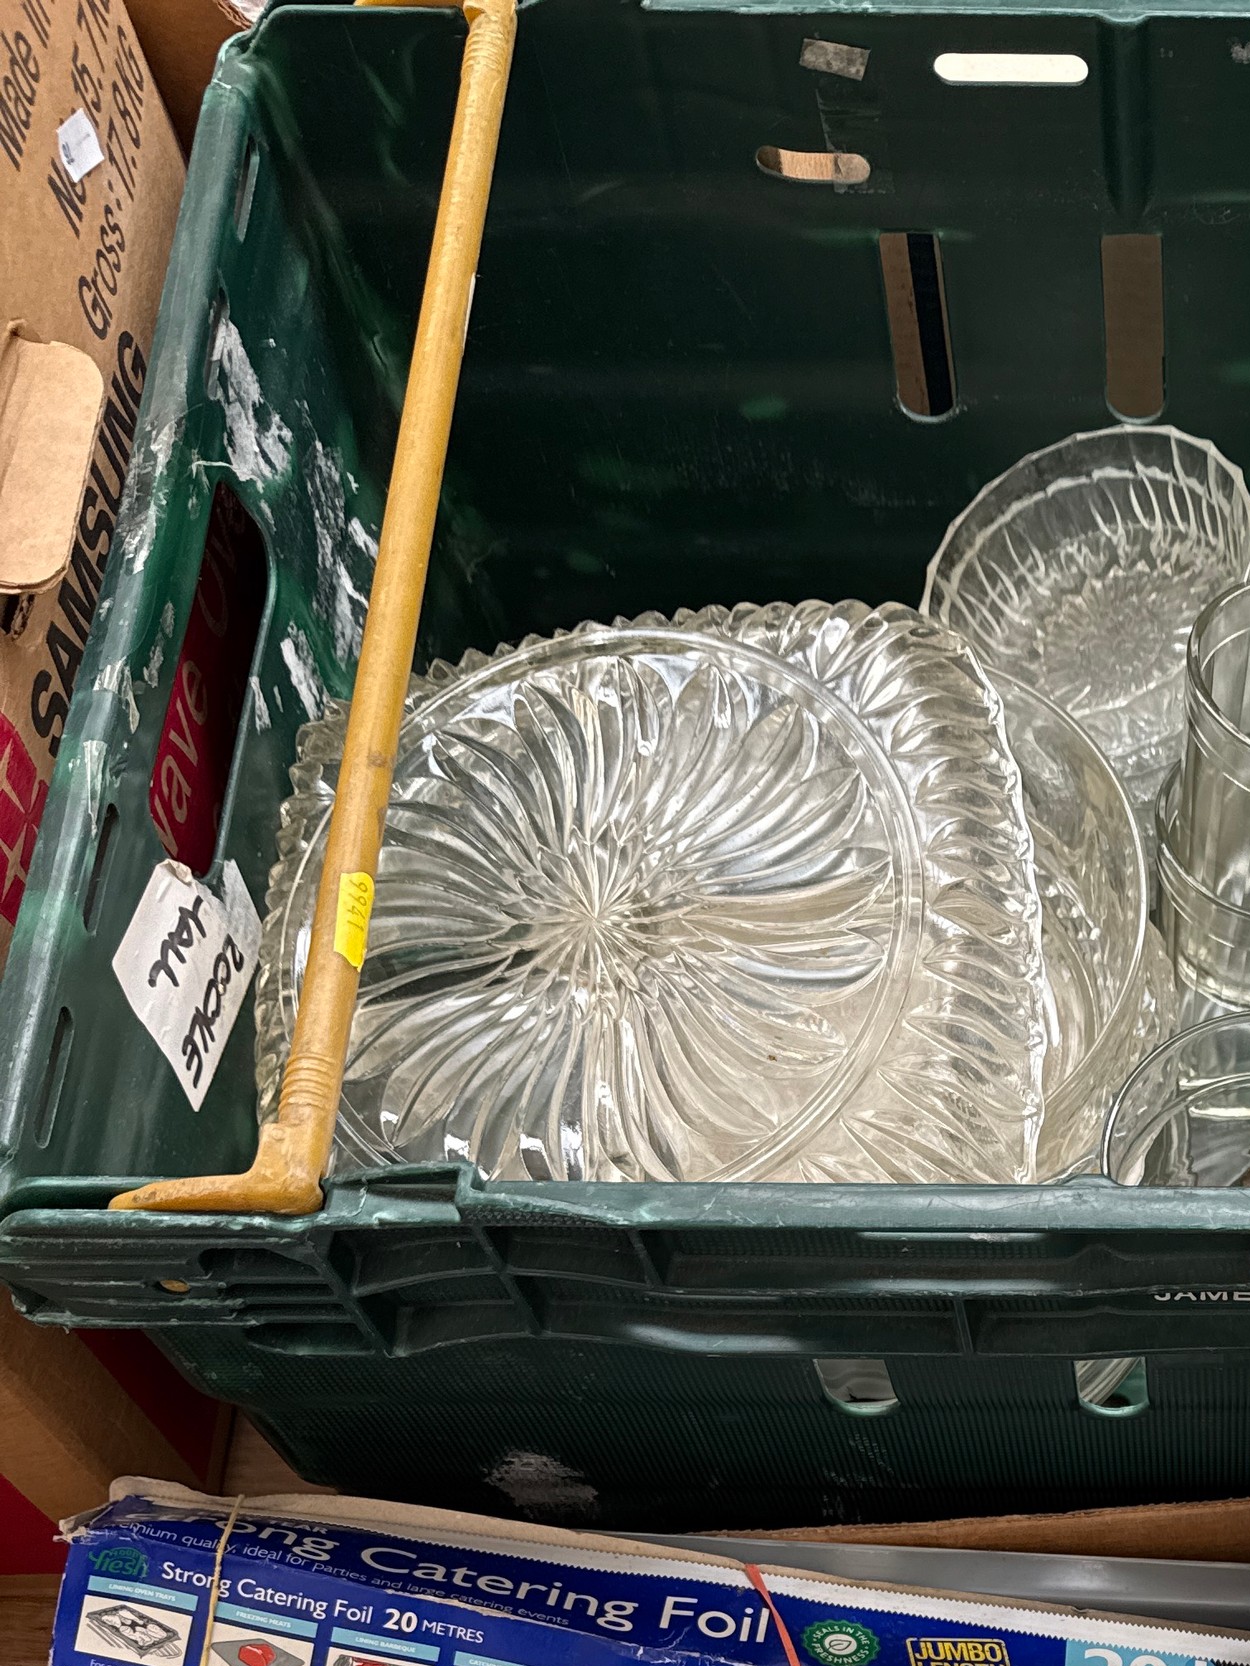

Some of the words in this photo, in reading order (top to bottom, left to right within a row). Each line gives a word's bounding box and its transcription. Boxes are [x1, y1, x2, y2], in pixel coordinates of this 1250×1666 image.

[31, 331, 147, 756] SAMSUNG
[237, 1578, 328, 1619] Catering
[335, 1600, 374, 1625] Foil
[382, 1608, 419, 1633] 20
[421, 1617, 485, 1644] METRES
[243, 1544, 282, 1561] ideal
[285, 1552, 311, 1566] for
[312, 1561, 368, 1582] parties
[371, 1576, 402, 1590] and
[407, 1583, 446, 1599] large
[450, 1594, 513, 1614] catering
[517, 1607, 570, 1626] events
[360, 1546, 639, 1632] Catering
[659, 1596, 770, 1643] Foil
[812, 1643, 870, 1664] FRESHNESS
[813, 1626, 840, 1639] SEALS
[914, 1641, 1003, 1662] JUMBO
